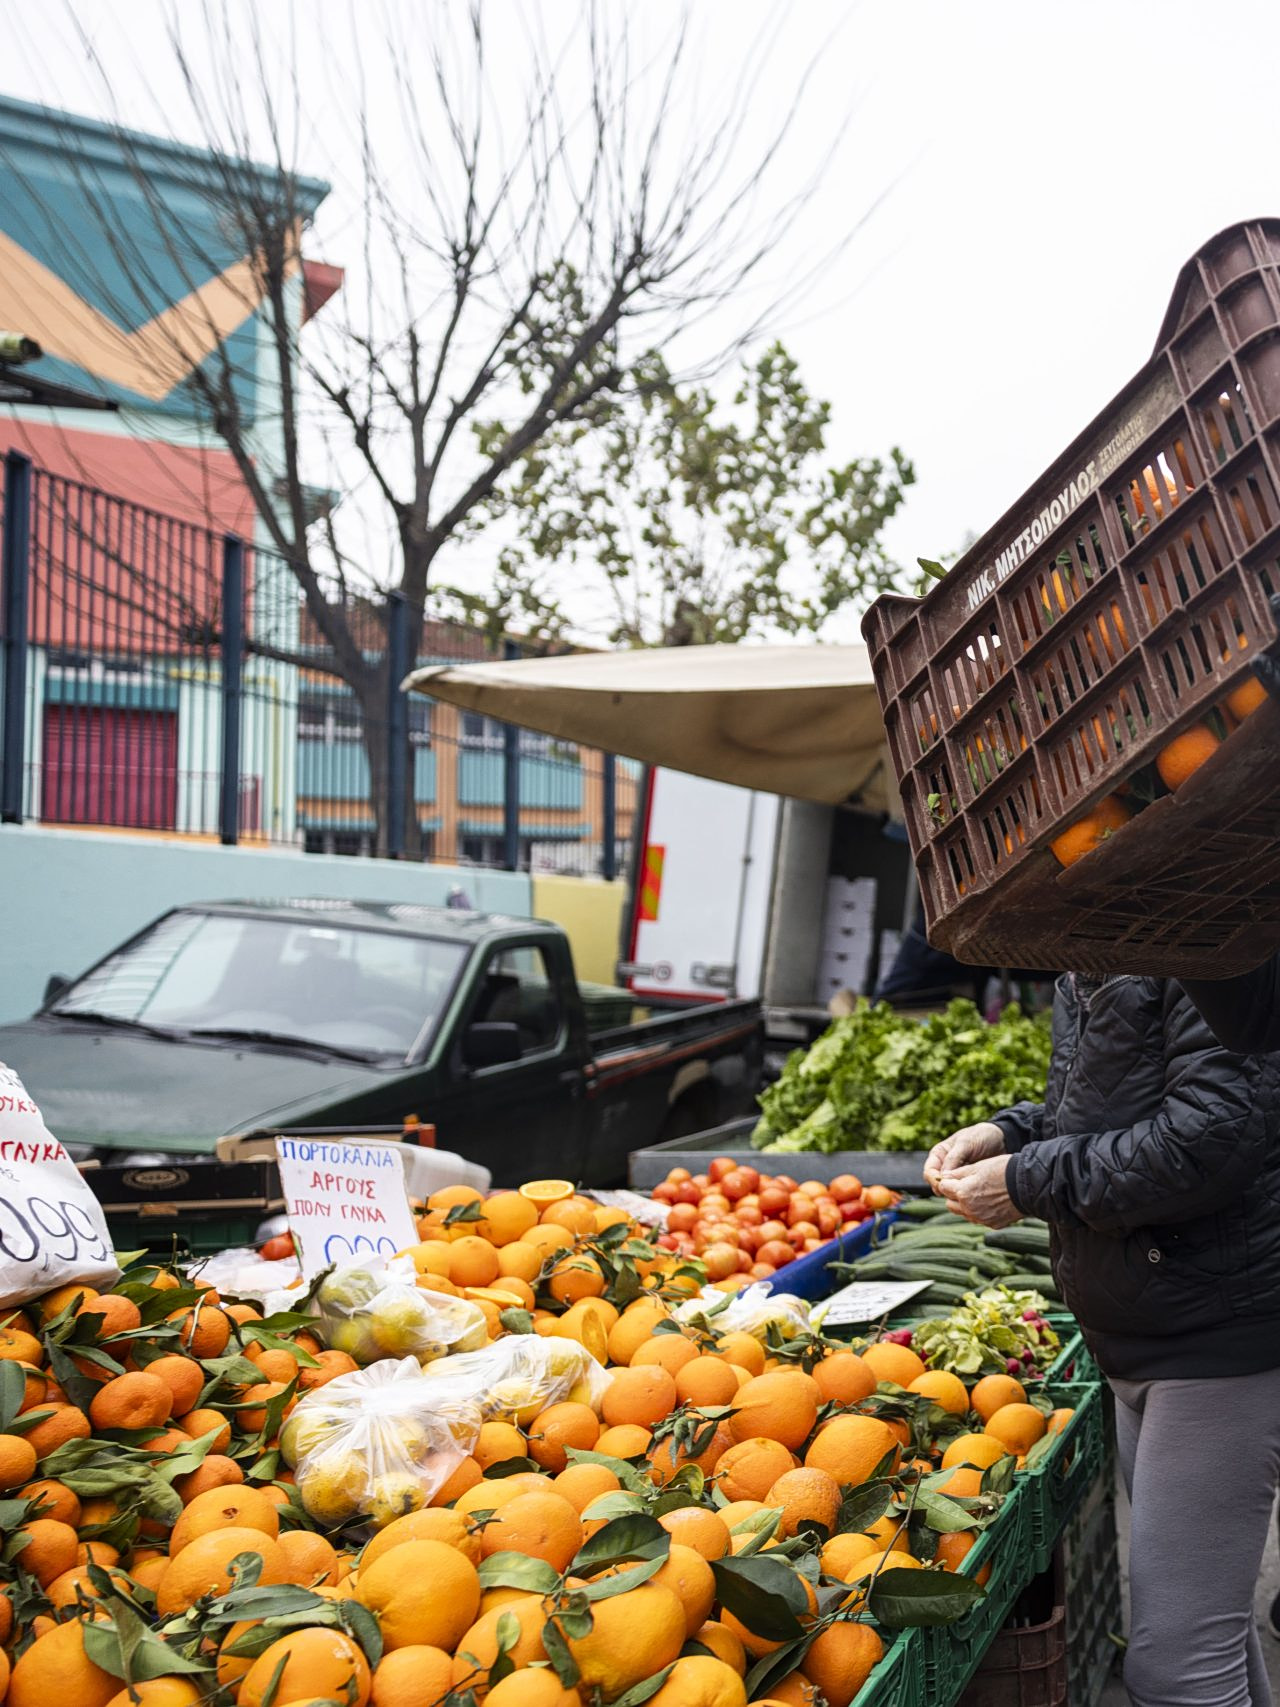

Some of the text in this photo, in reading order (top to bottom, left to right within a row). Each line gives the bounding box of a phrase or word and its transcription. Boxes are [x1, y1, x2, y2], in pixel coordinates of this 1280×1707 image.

[967, 461, 1099, 610] ΝΙΚ. ΜΗΤΣΟΠΟΥΛΟΣ
[282, 1141, 394, 1168] ΠΟΡΤΟΚΑΛΙΑ
[310, 1170, 376, 1199] ΑΡΓΟΥΣ
[289, 1199, 386, 1223] ΠΟΛΥ ΓΛΥΚΑ
